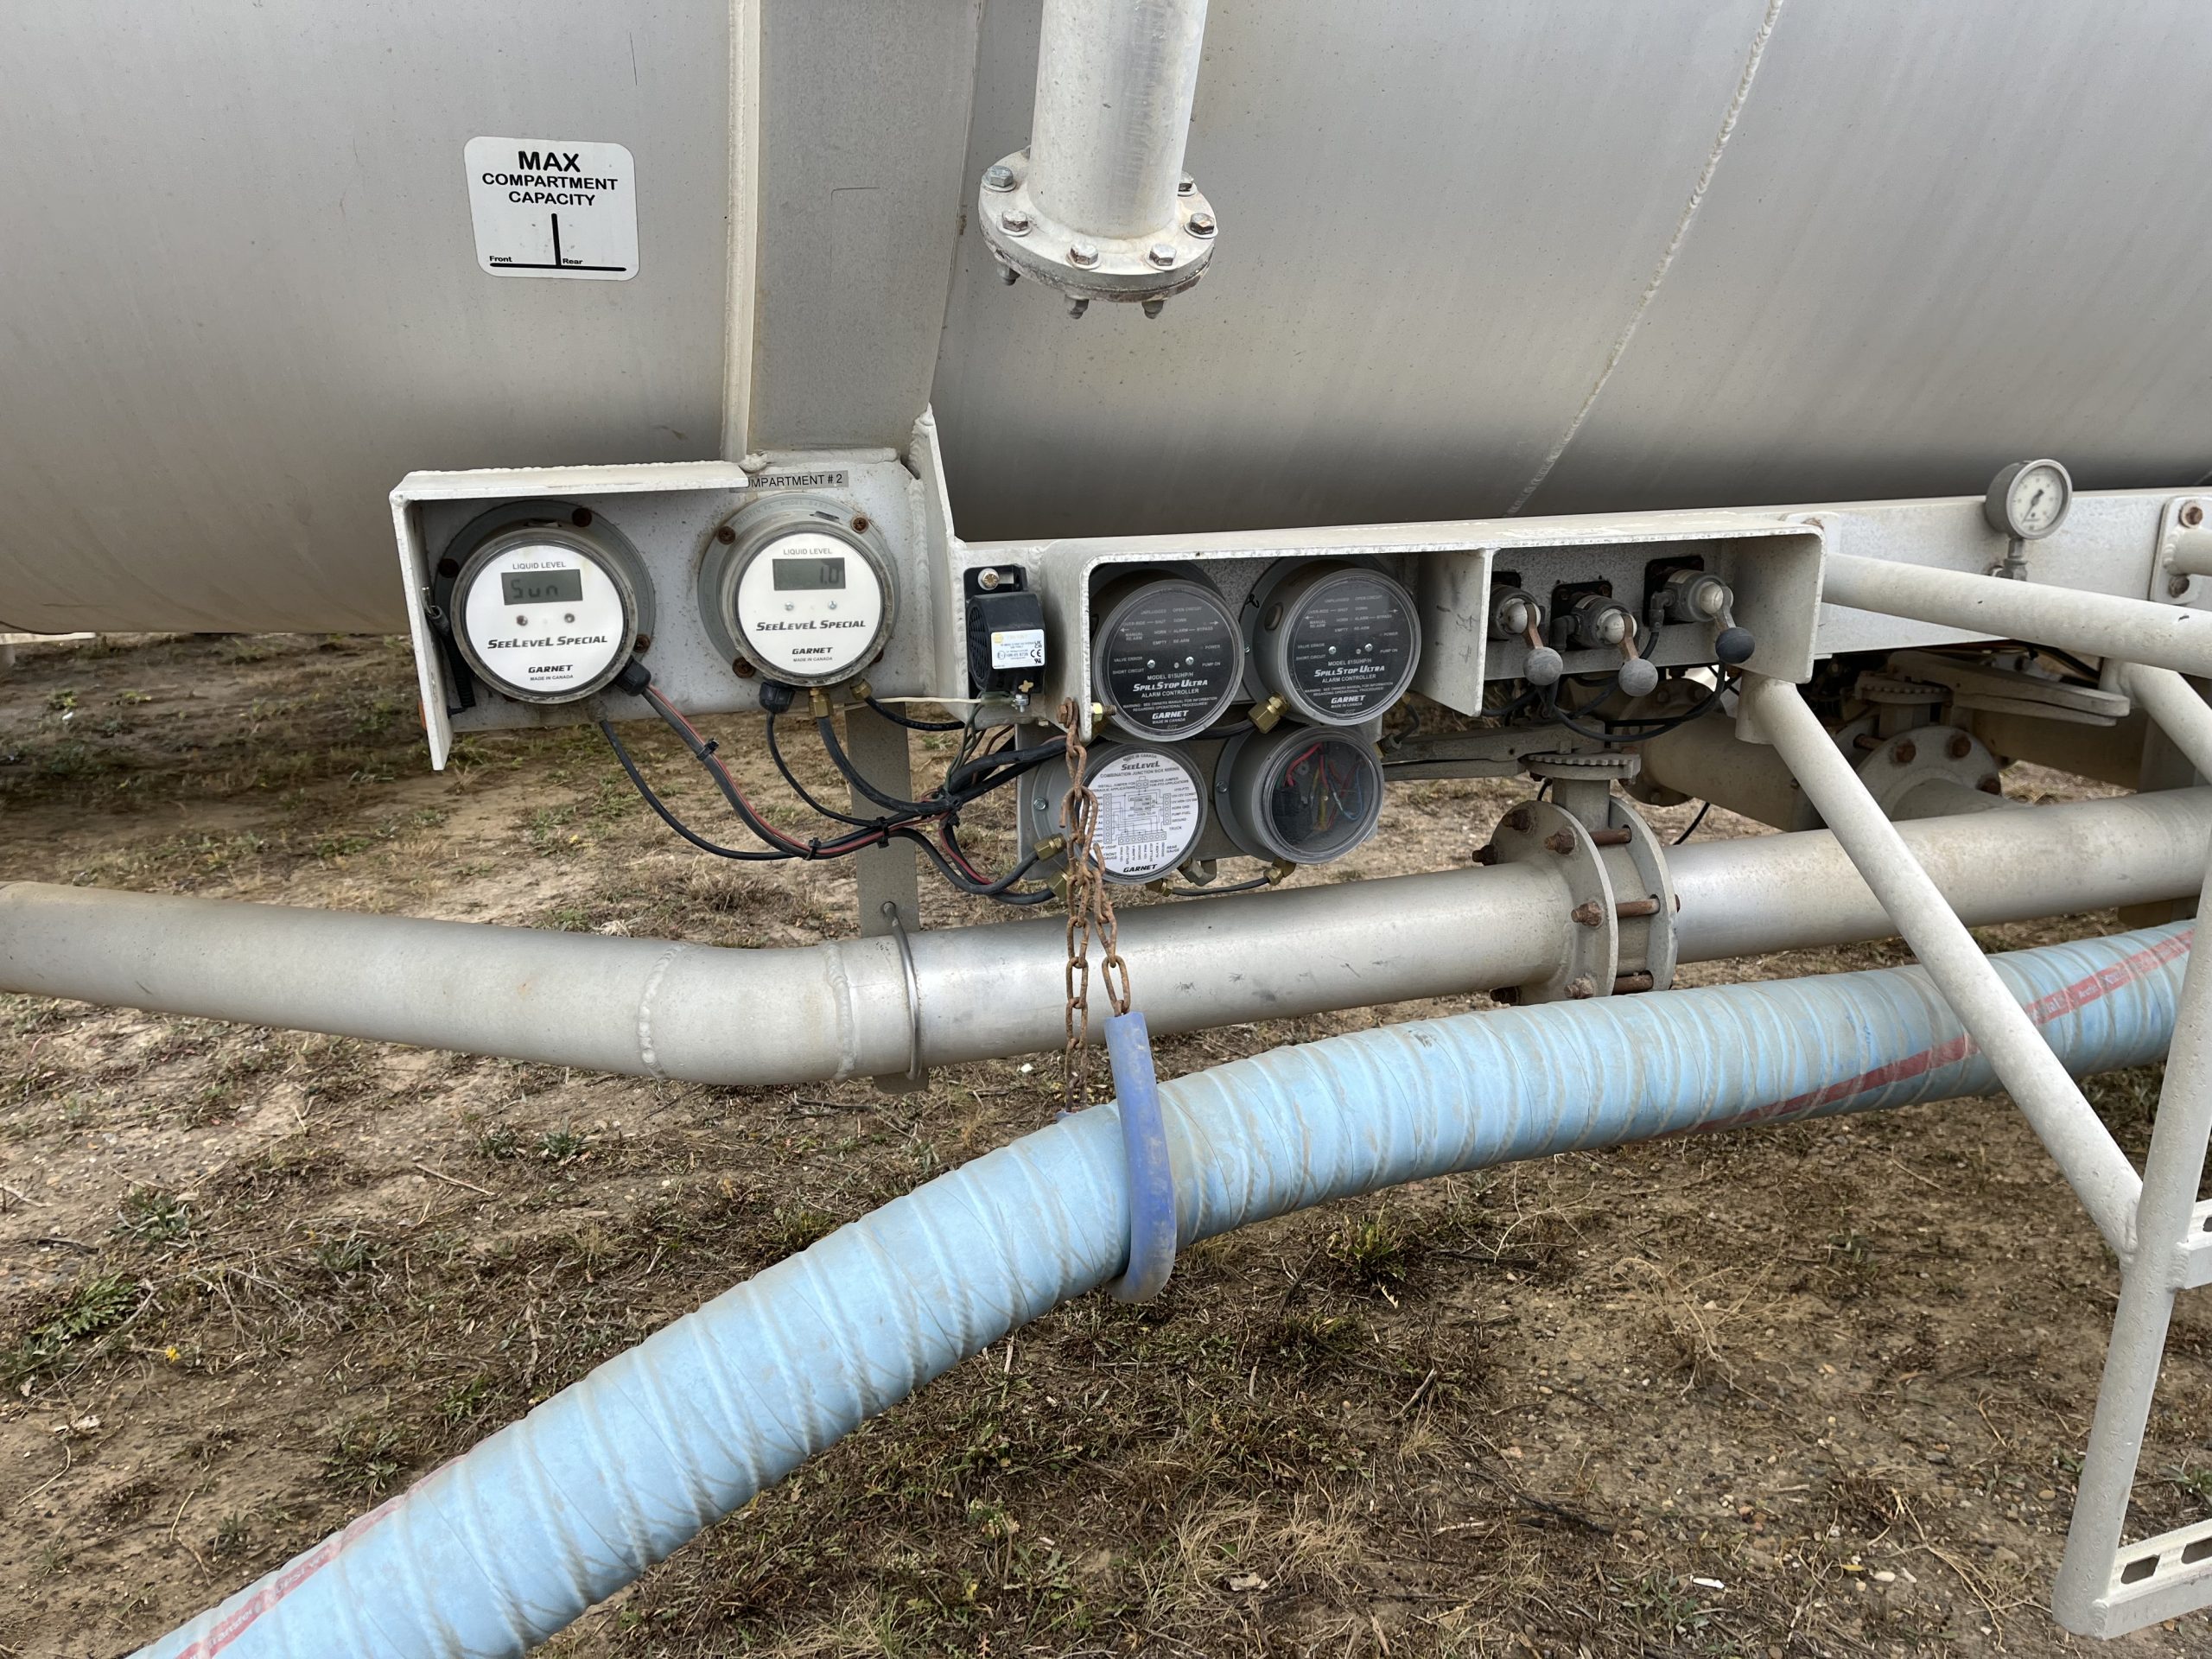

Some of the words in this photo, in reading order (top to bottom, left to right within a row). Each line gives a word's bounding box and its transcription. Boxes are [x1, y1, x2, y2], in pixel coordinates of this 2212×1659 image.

[518, 150, 581, 172] MAX
[482, 173, 618, 190] COMPARTMENT
[509, 191, 595, 206] CAPACITY
[747, 474, 824, 488] MPARTMENT
[828, 474, 834, 484] #
[836, 474, 842, 484] 2
[819, 620, 867, 629] SPECIAL
[556, 635, 608, 645] SPECIAL
[528, 664, 573, 674] GARNET
[1331, 695, 1365, 703] GARNET
[1152, 710, 1189, 719] GARNET
[1123, 864, 1157, 873] GARNET
